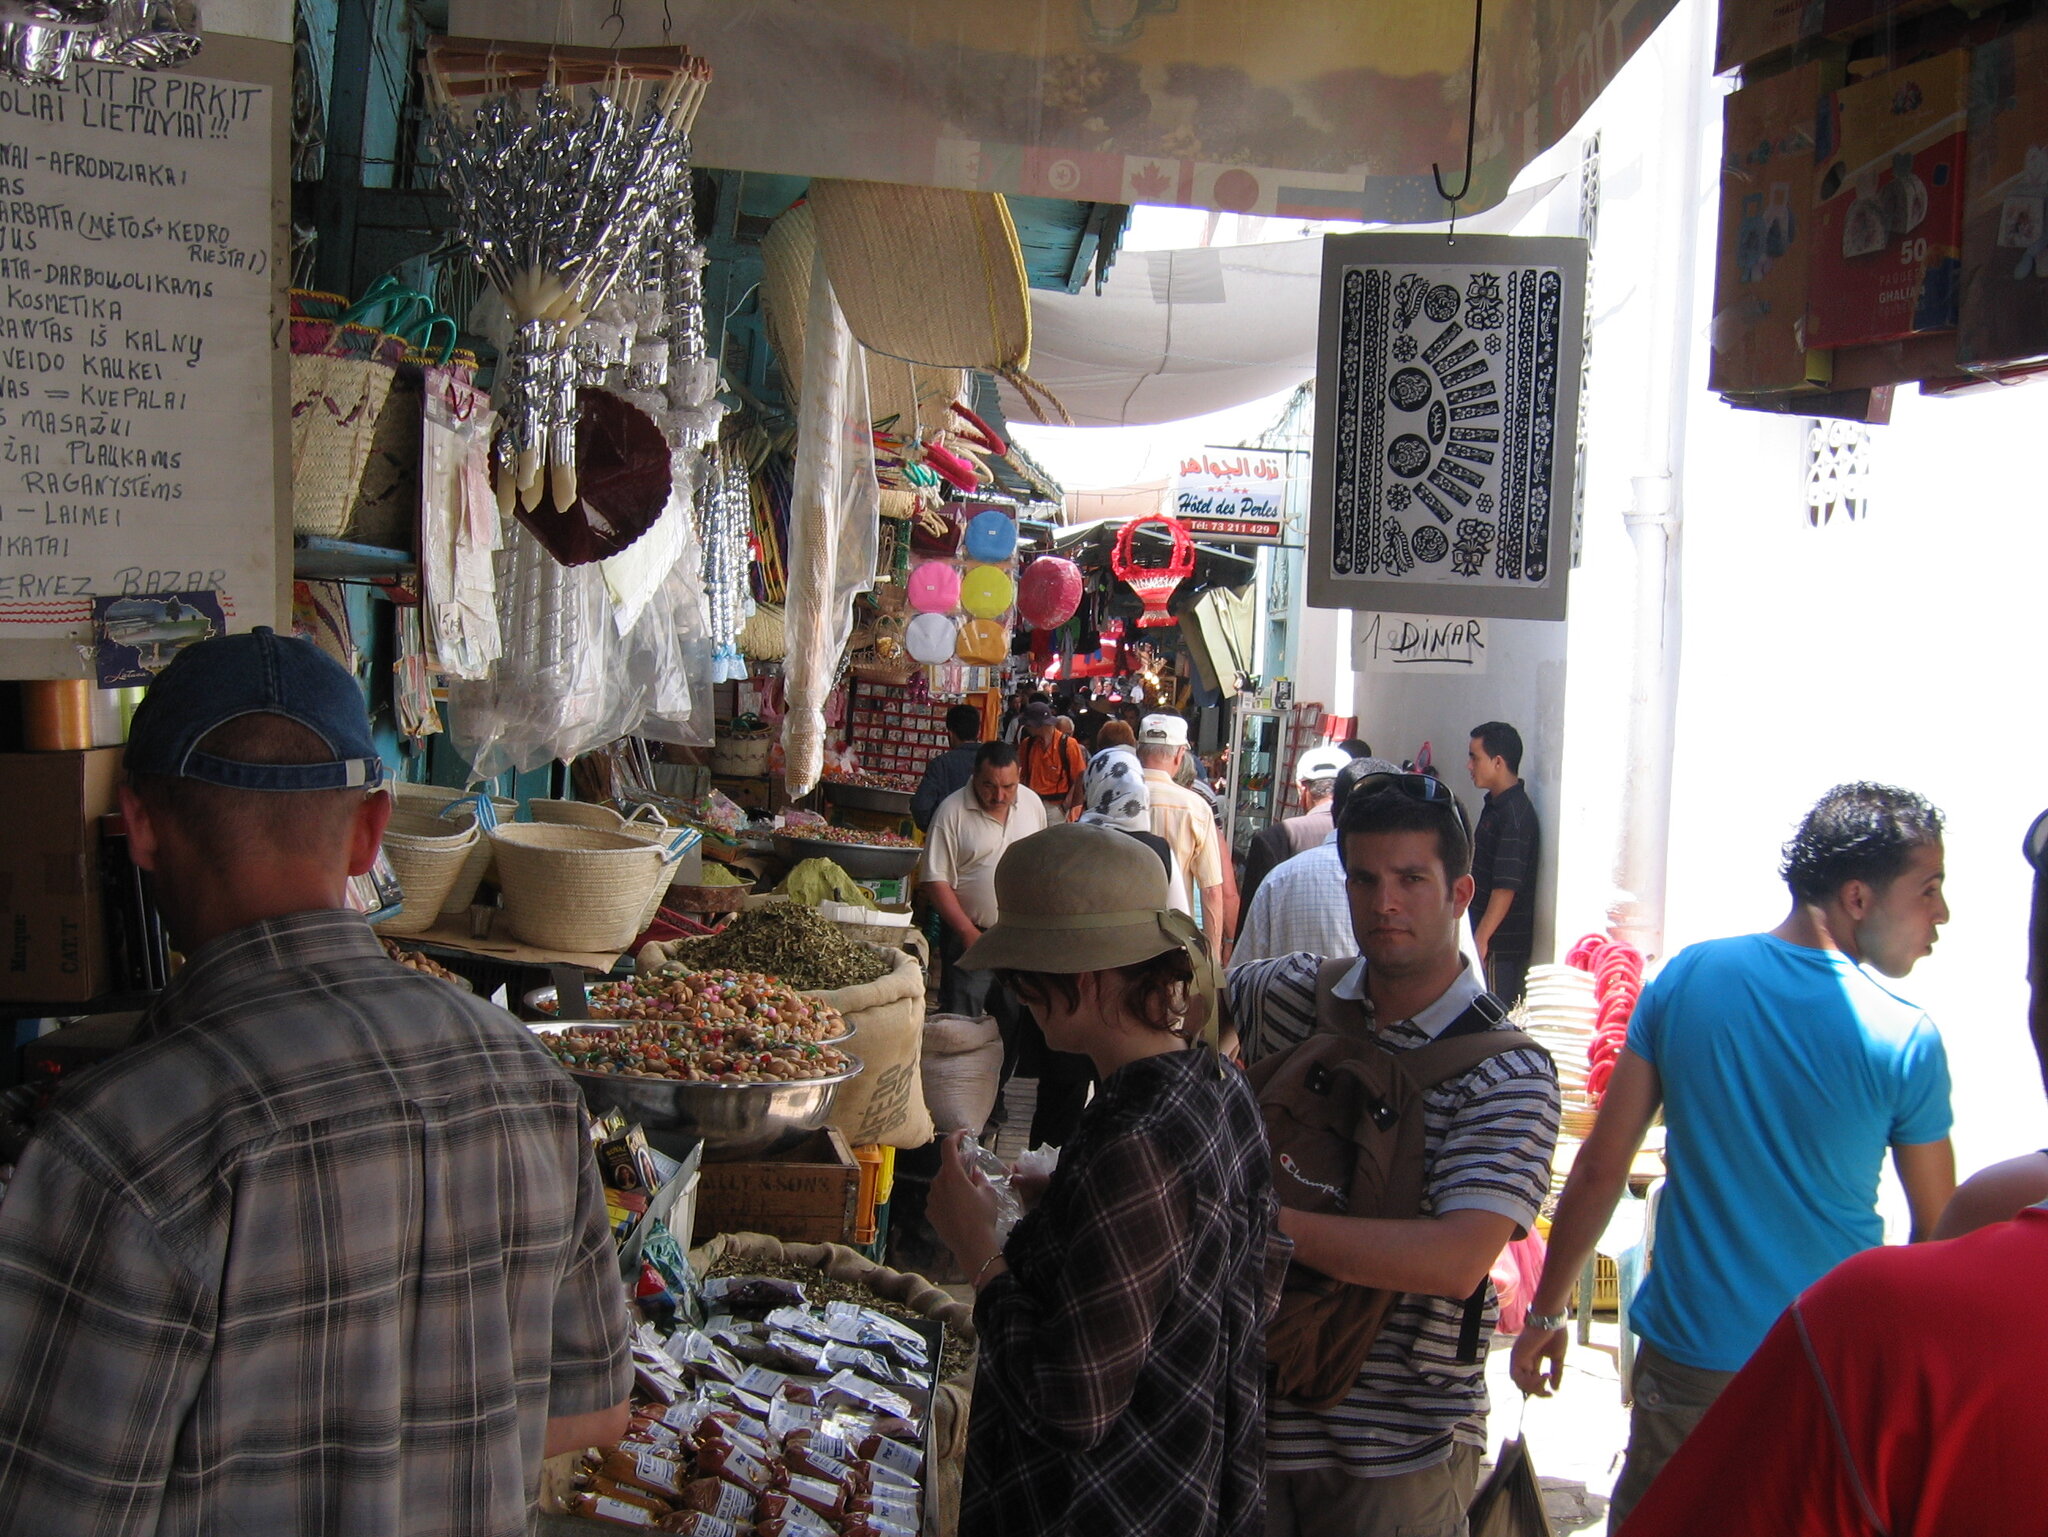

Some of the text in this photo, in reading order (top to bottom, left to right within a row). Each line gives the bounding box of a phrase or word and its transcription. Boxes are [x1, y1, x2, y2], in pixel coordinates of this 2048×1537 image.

[133, 77, 156, 107] IR
[166, 80, 262, 121] PIRKIT
[1901, 237, 1927, 264] 50
[7, 285, 122, 321] KOSMETIKA
[4, 347, 162, 381] VEIDO KAUKEI
[81, 383, 187, 410] KVEPALAI
[66, 440, 182, 470] PLAUKAMS
[45, 501, 121, 527] LAIMEI
[1178, 492, 1278, 519] Hôtel des Perles
[1211, 521, 1224, 532] 73
[1227, 523, 1246, 533] 211
[1249, 525, 1270, 535] 429
[113, 566, 226, 595] BAZAR
